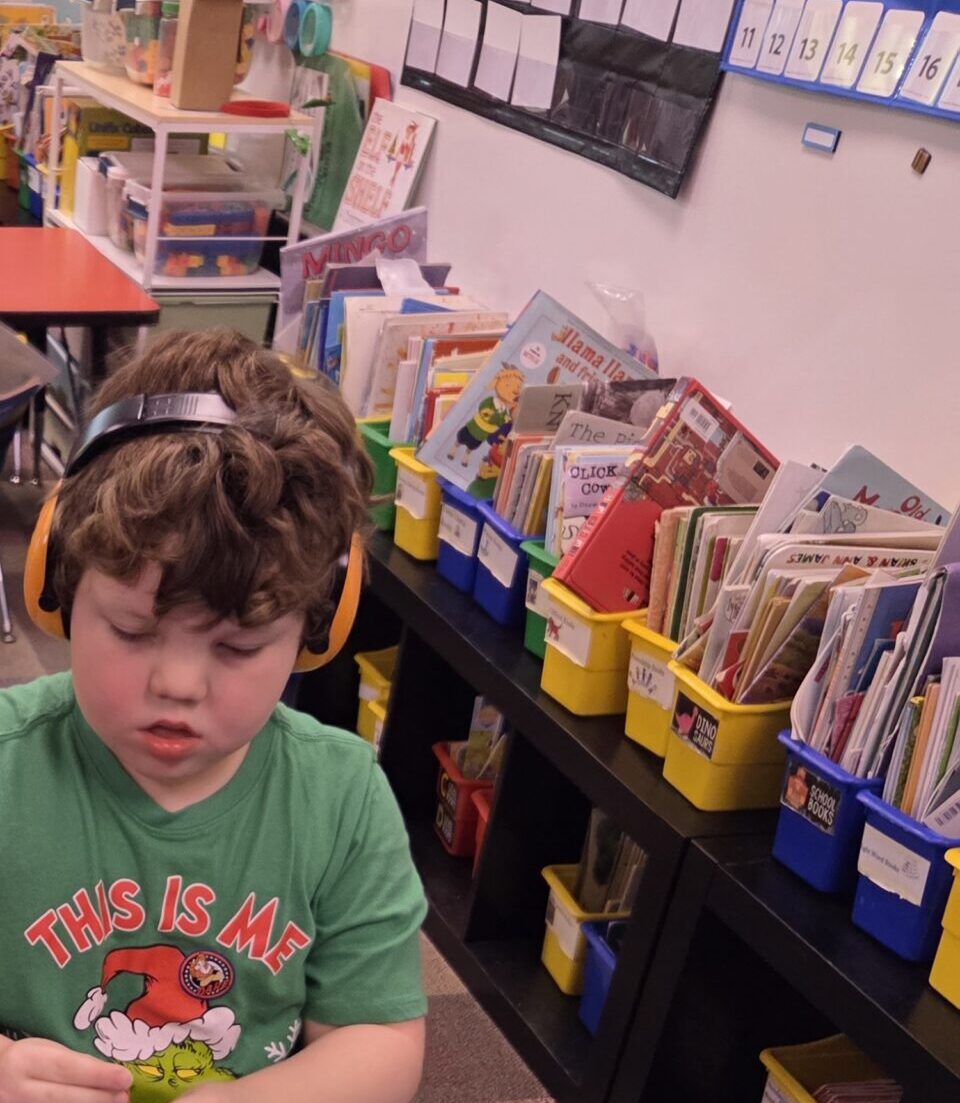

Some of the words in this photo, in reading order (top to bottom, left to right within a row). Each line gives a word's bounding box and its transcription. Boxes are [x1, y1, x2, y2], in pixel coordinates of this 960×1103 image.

[742, 27, 756, 49] 11
[768, 33, 786, 55] 12
[798, 38, 819, 60] 13
[836, 43, 859, 66] 14
[873, 51, 898, 74] 15
[918, 55, 942, 80] 16
[303, 224, 412, 278] MINGO
[556, 353, 580, 373] and
[603, 359, 634, 382] lla
[570, 423, 606, 443] The
[570, 465, 618, 481] CLICK
[786, 553, 826, 564] JAMES
[832, 555, 863, 566] ANN
[866, 555, 878, 567] &
[695, 714, 718, 741] DINO
[692, 731, 713, 754] SAURS
[809, 785, 837, 813] SCHOOL
[807, 800, 835, 826] BOOKS
[24, 878, 146, 969] THIS
[157, 875, 216, 936] IS
[216, 891, 312, 976] ME
